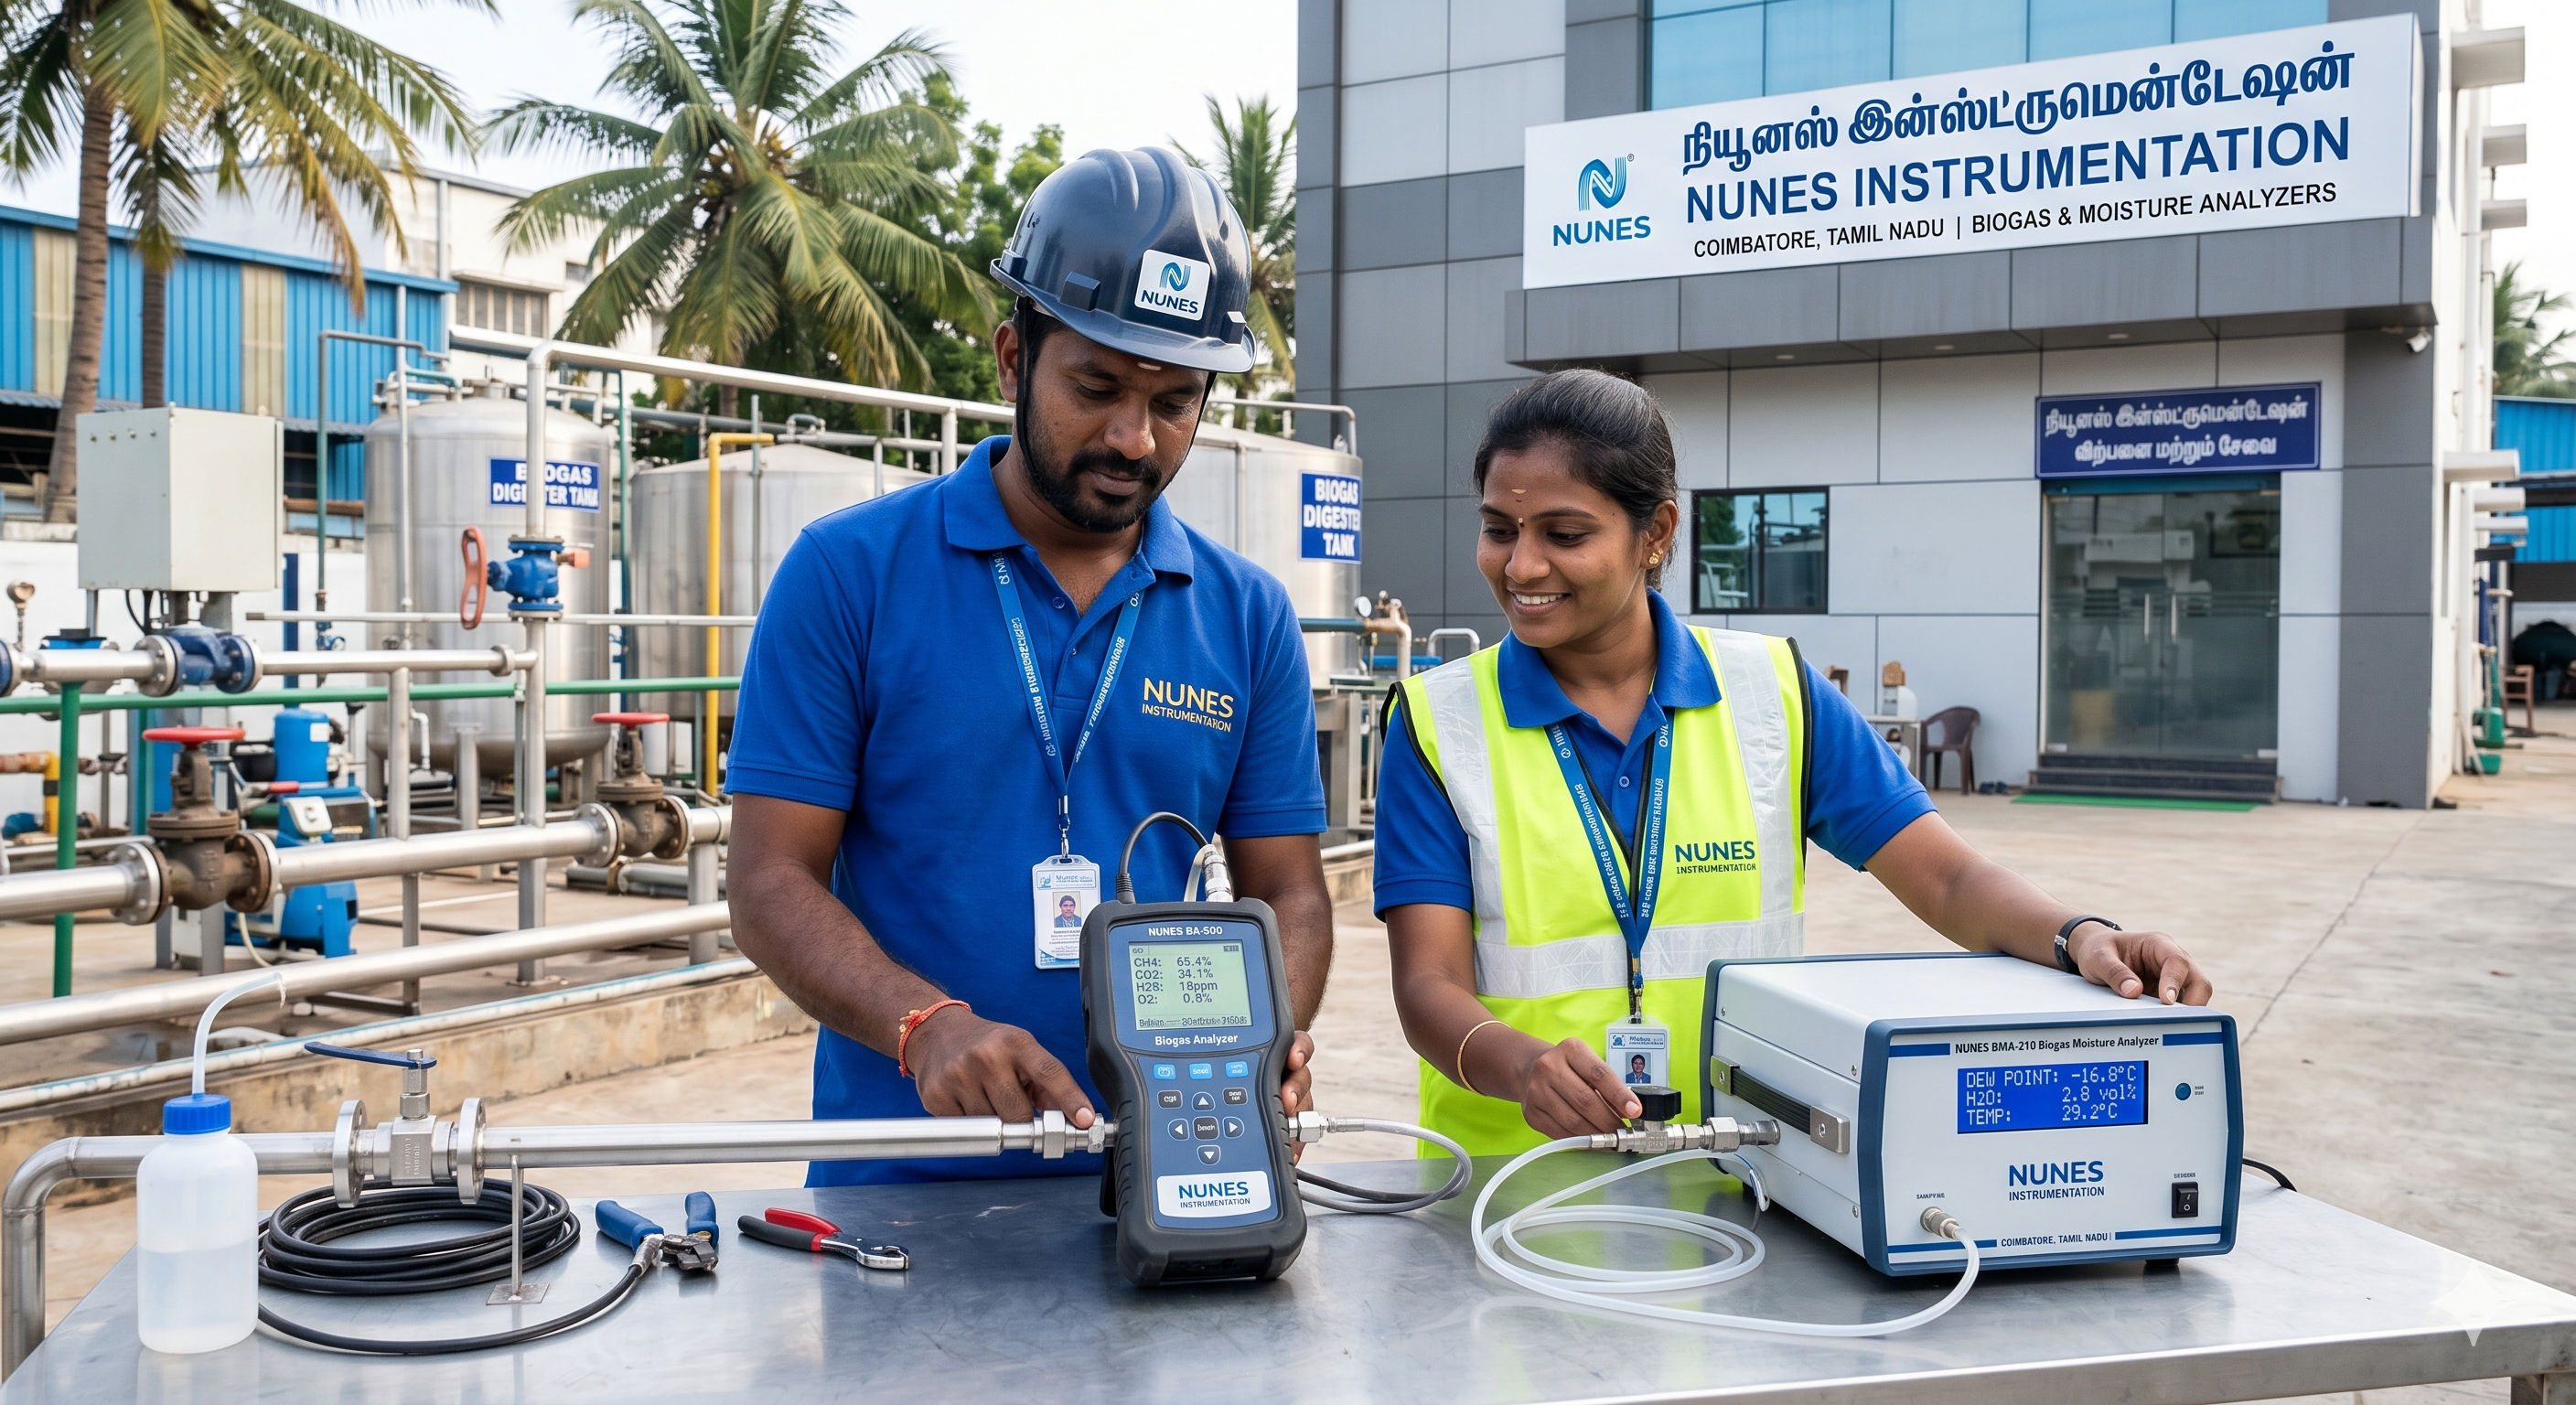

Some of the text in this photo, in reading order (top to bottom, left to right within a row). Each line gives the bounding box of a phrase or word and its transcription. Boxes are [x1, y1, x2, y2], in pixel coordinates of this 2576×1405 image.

[1682, 105, 1839, 177] நியூனஸ்
[1687, 116, 2349, 224] NUNES INSTRUMENTATION
[1553, 215, 1651, 246] NUNES
[1694, 230, 1820, 258] COIMBATORE,
[1827, 224, 1884, 246] TAMIL
[1889, 218, 1944, 241] NADU
[1972, 209, 2051, 233] BIOGAS
[2058, 207, 2072, 226] &
[2079, 195, 2193, 223] MOISTURE
[2199, 182, 2337, 213] ANALYZERS
[1141, 289, 1199, 314] NUNES
[515, 462, 592, 486] BOGAS
[1315, 478, 1358, 505] BIOGAS
[1323, 532, 1356, 557] TANK
[1143, 677, 1234, 718] NUNES
[1675, 841, 1755, 863] NUNES
[1148, 927, 1183, 937] NUNES
[1134, 956, 1212, 967] CH4: 65.4%
[1135, 969, 1214, 980] CO2: 34.1%
[1138, 992, 1212, 1004] O2: 0.8%
[1179, 981, 1218, 993] 18ppm
[1154, 1035, 1239, 1048] Biogas Analyzer
[1955, 1035, 2159, 1054] NUNES BMA-210 Biogas Moisture Analyzer
[1966, 1065, 2137, 1088] DEW POINT: -16.8°C
[2062, 1086, 2090, 1103] 2.8
[2099, 1084, 2137, 1100] vol%
[1967, 1102, 2118, 1125] TEMP: 29.2°C
[2009, 1160, 2104, 1186] NUNES
[1178, 1181, 1250, 1199] NUNES
[2009, 1186, 2104, 1202] INSTRUMENTATION
[1180, 1197, 1250, 1209] INSTRUMENTATION
[2057, 1234, 2083, 1244] TAMIL
[2086, 1232, 2108, 1242] NADU
